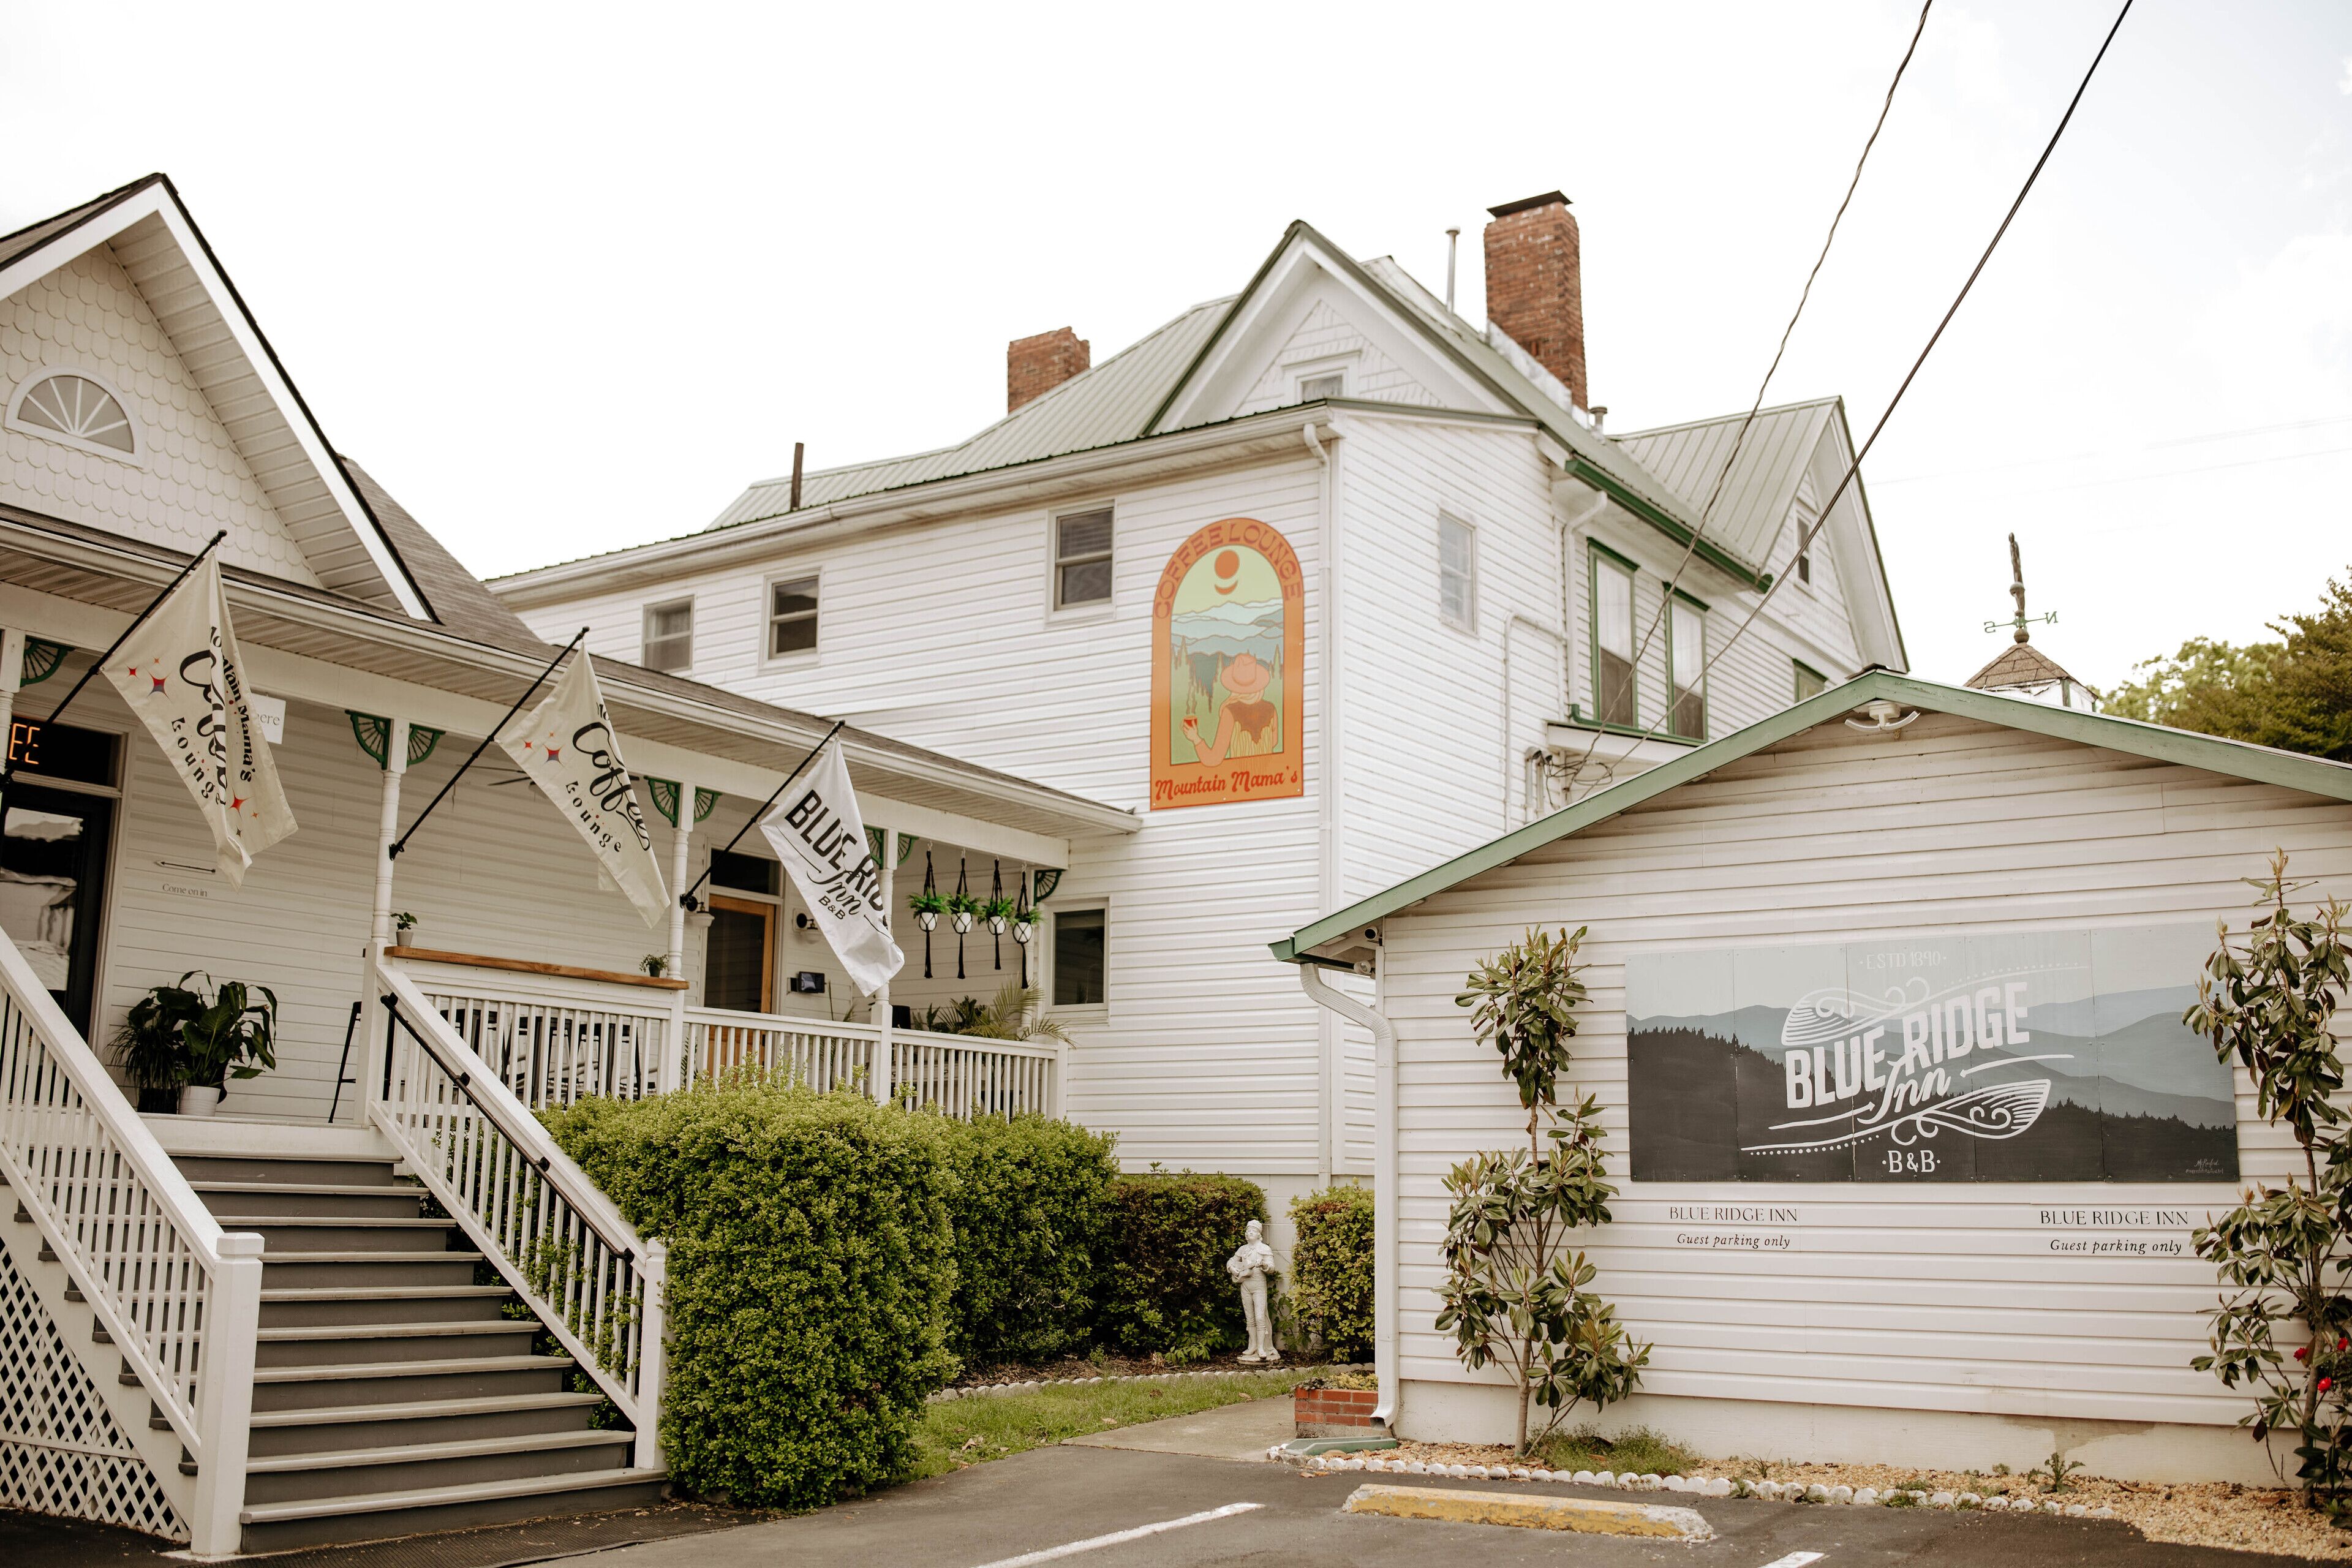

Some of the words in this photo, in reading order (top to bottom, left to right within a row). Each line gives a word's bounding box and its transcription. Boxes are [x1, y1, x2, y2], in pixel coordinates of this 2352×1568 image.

[1155, 526, 1224, 619] COFFEE
[1227, 522, 1302, 601] LOUNGE
[257, 713, 280, 726] ere
[1155, 774, 1226, 801] Mountain
[1231, 765, 1298, 793] Mama's
[565, 781, 622, 853] Lounge
[785, 789, 858, 871] BLUE
[162, 883, 186, 894] Come
[818, 895, 846, 920] B&B
[1911, 951, 1941, 967] 1890
[1785, 1025, 1886, 1108] BLUE
[1902, 982, 2030, 1076] RIDGE
[1857, 1051, 1951, 1125] Inn
[1670, 1207, 1709, 1220] BLUE
[1715, 1208, 1764, 1221] RIDGE
[1770, 1208, 1797, 1222] INN
[2040, 1210, 2087, 1225] BLUE
[2092, 1211, 2150, 1225] RIDGE
[2157, 1211, 2188, 1225] INN
[1677, 1234, 1709, 1245] Guest
[1712, 1234, 1760, 1250] parking
[1764, 1235, 1790, 1250] only
[2050, 1239, 2087, 1251] Guest
[2092, 1239, 2147, 1254] parking
[2152, 1240, 2182, 1256] only
